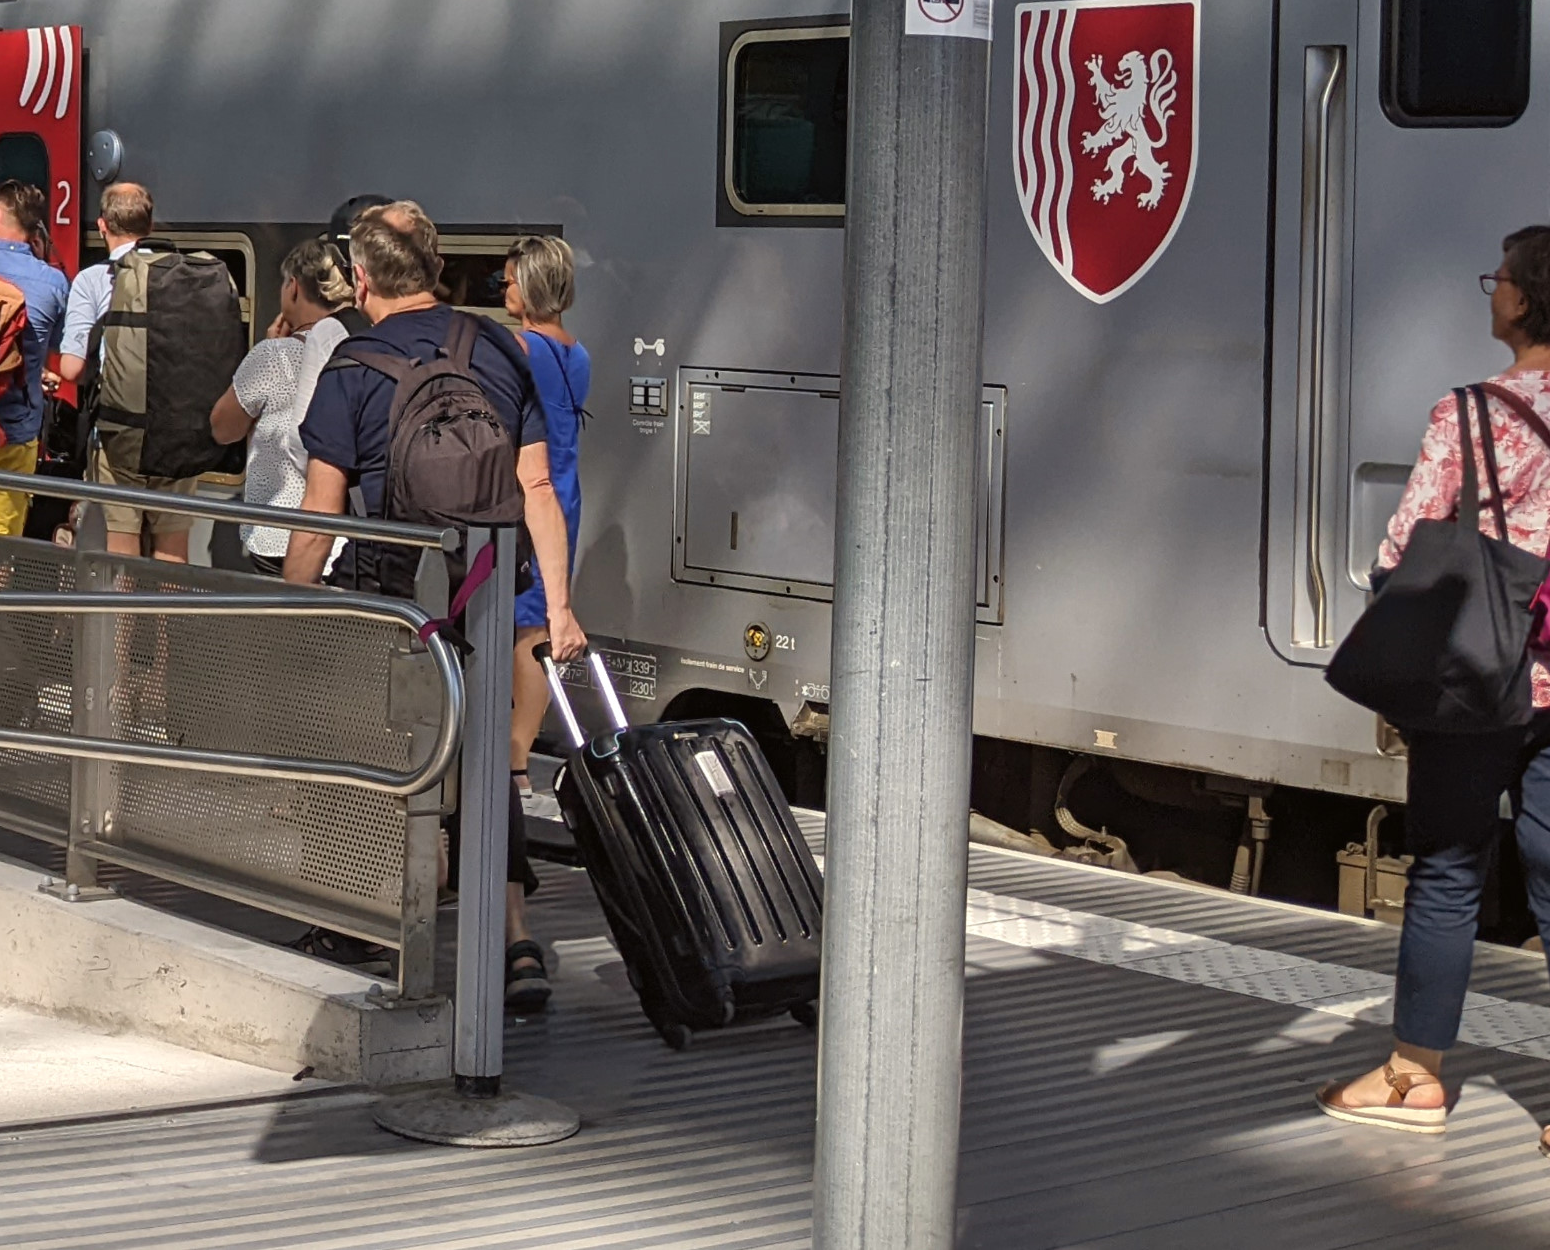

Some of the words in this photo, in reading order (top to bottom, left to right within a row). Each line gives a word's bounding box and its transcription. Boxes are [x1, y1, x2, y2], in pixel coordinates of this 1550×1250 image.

[56, 180, 71, 225] 2
[774, 634, 790, 650] 22
[790, 636, 796, 651] t
[633, 659, 650, 674] 339
[725, 664, 746, 674] service
[632, 681, 649, 695] 230
